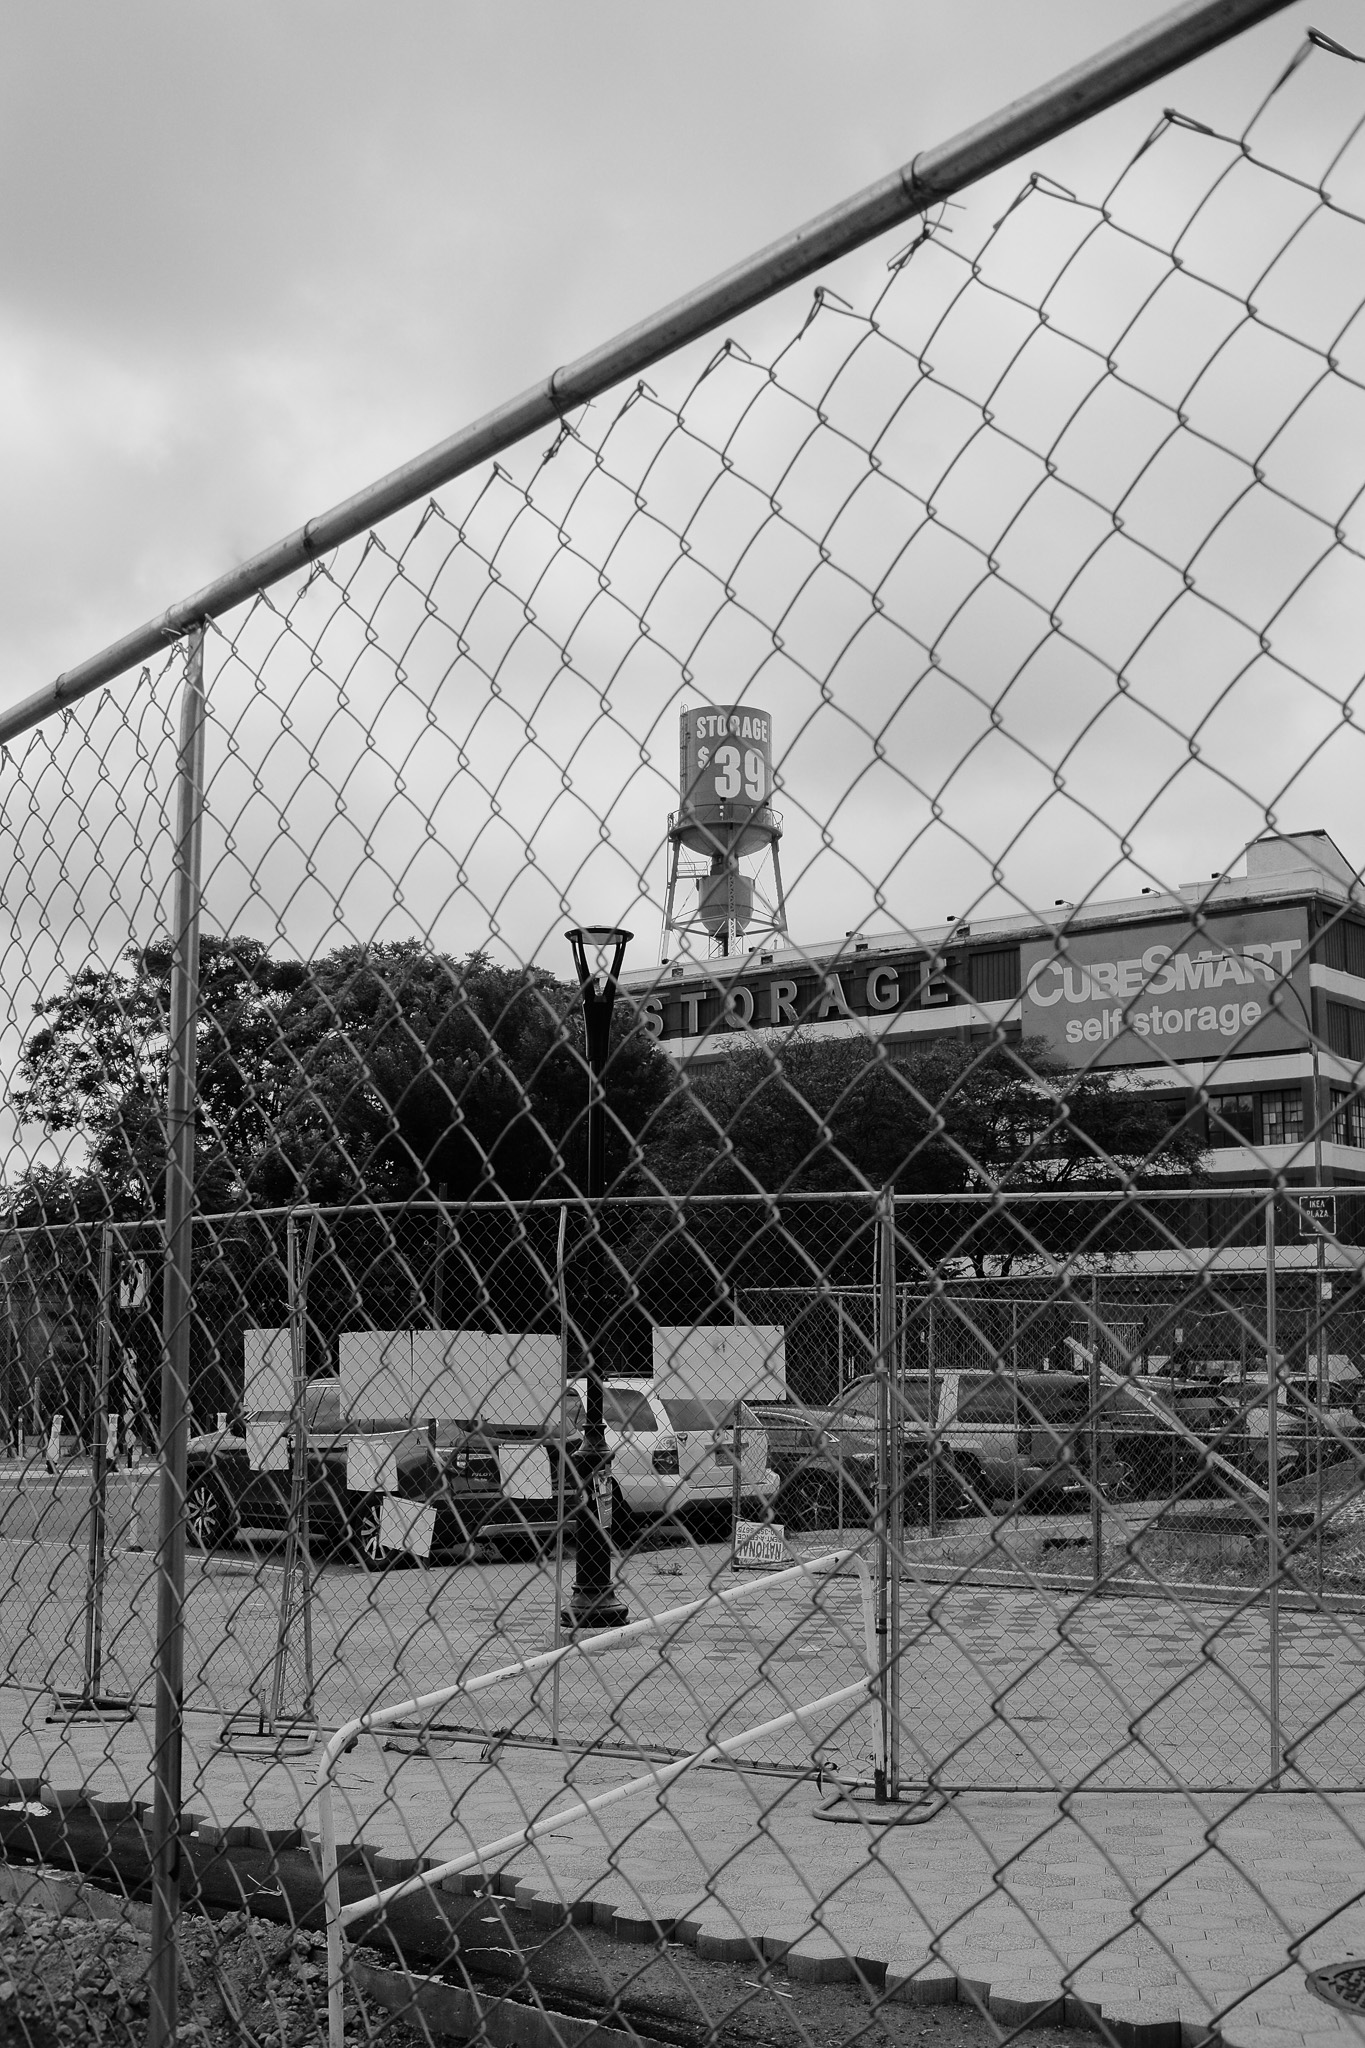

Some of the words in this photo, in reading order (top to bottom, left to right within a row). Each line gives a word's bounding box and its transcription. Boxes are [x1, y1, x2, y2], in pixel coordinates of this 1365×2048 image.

[696, 715, 767, 743] STORAGE
[640, 958, 950, 1038] STORAGE
[1065, 1007, 1124, 1043] self
[1132, 1001, 1262, 1036] storage
[1309, 1200, 1325, 1208] IKEA
[1306, 1210, 1329, 1218] PLAZA
[737, 1534, 781, 1543] RENT-A-FECE
[737, 1541, 781, 1560] NATIONAL
